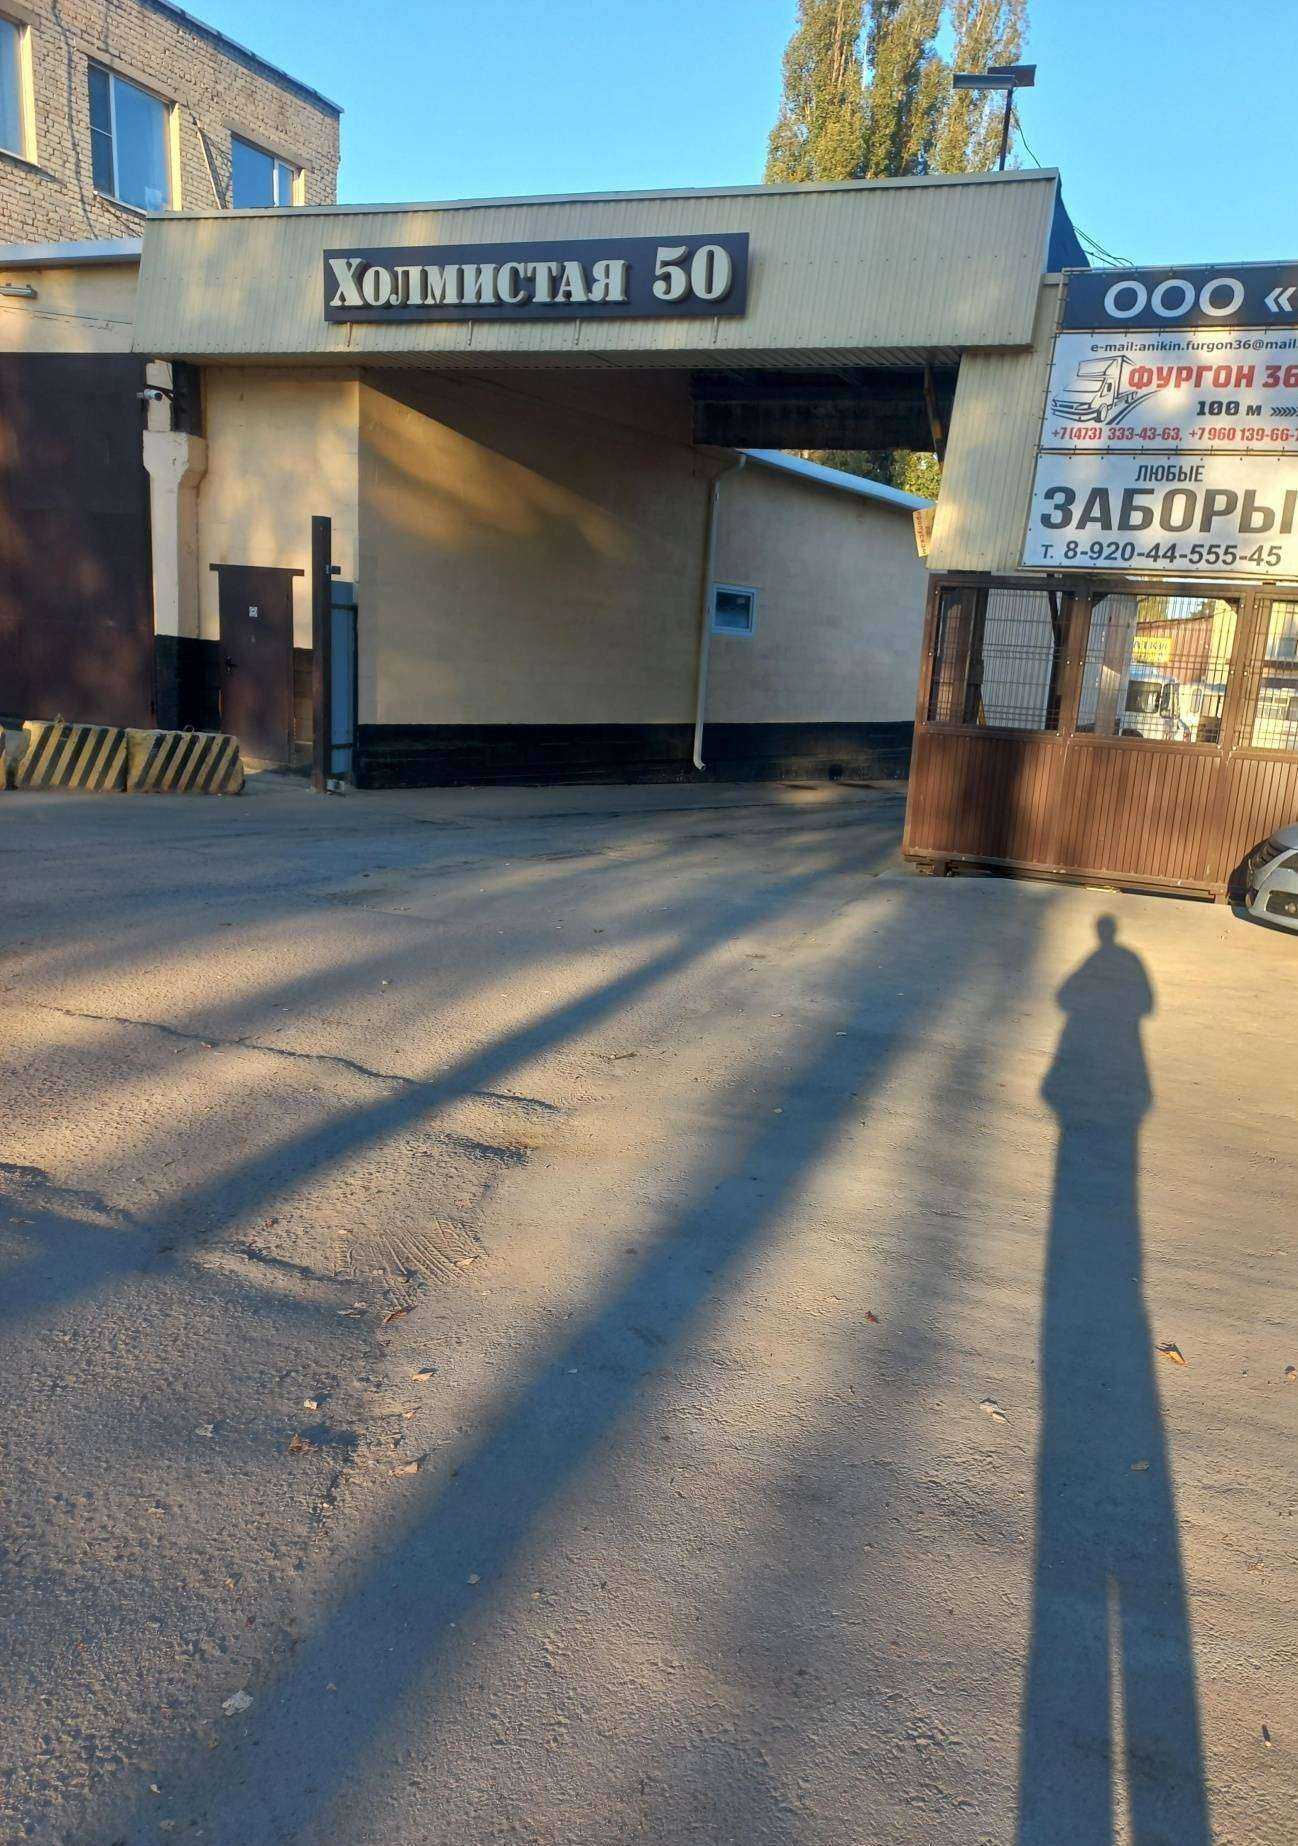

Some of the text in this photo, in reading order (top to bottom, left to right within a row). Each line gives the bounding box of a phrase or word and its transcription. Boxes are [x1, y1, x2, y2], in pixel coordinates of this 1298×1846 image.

[652, 244, 733, 301] 50
[1104, 277, 1245, 318] ООО
[1128, 364, 1298, 390] ФУРГОН 36
[1196, 400, 1240, 417] 100
[1134, 464, 1205, 483] ЛЮБЫЕ
[1040, 486, 1298, 534] ЗАБОРЫ
[1063, 540, 1282, 567] 8-920-44-555-45
